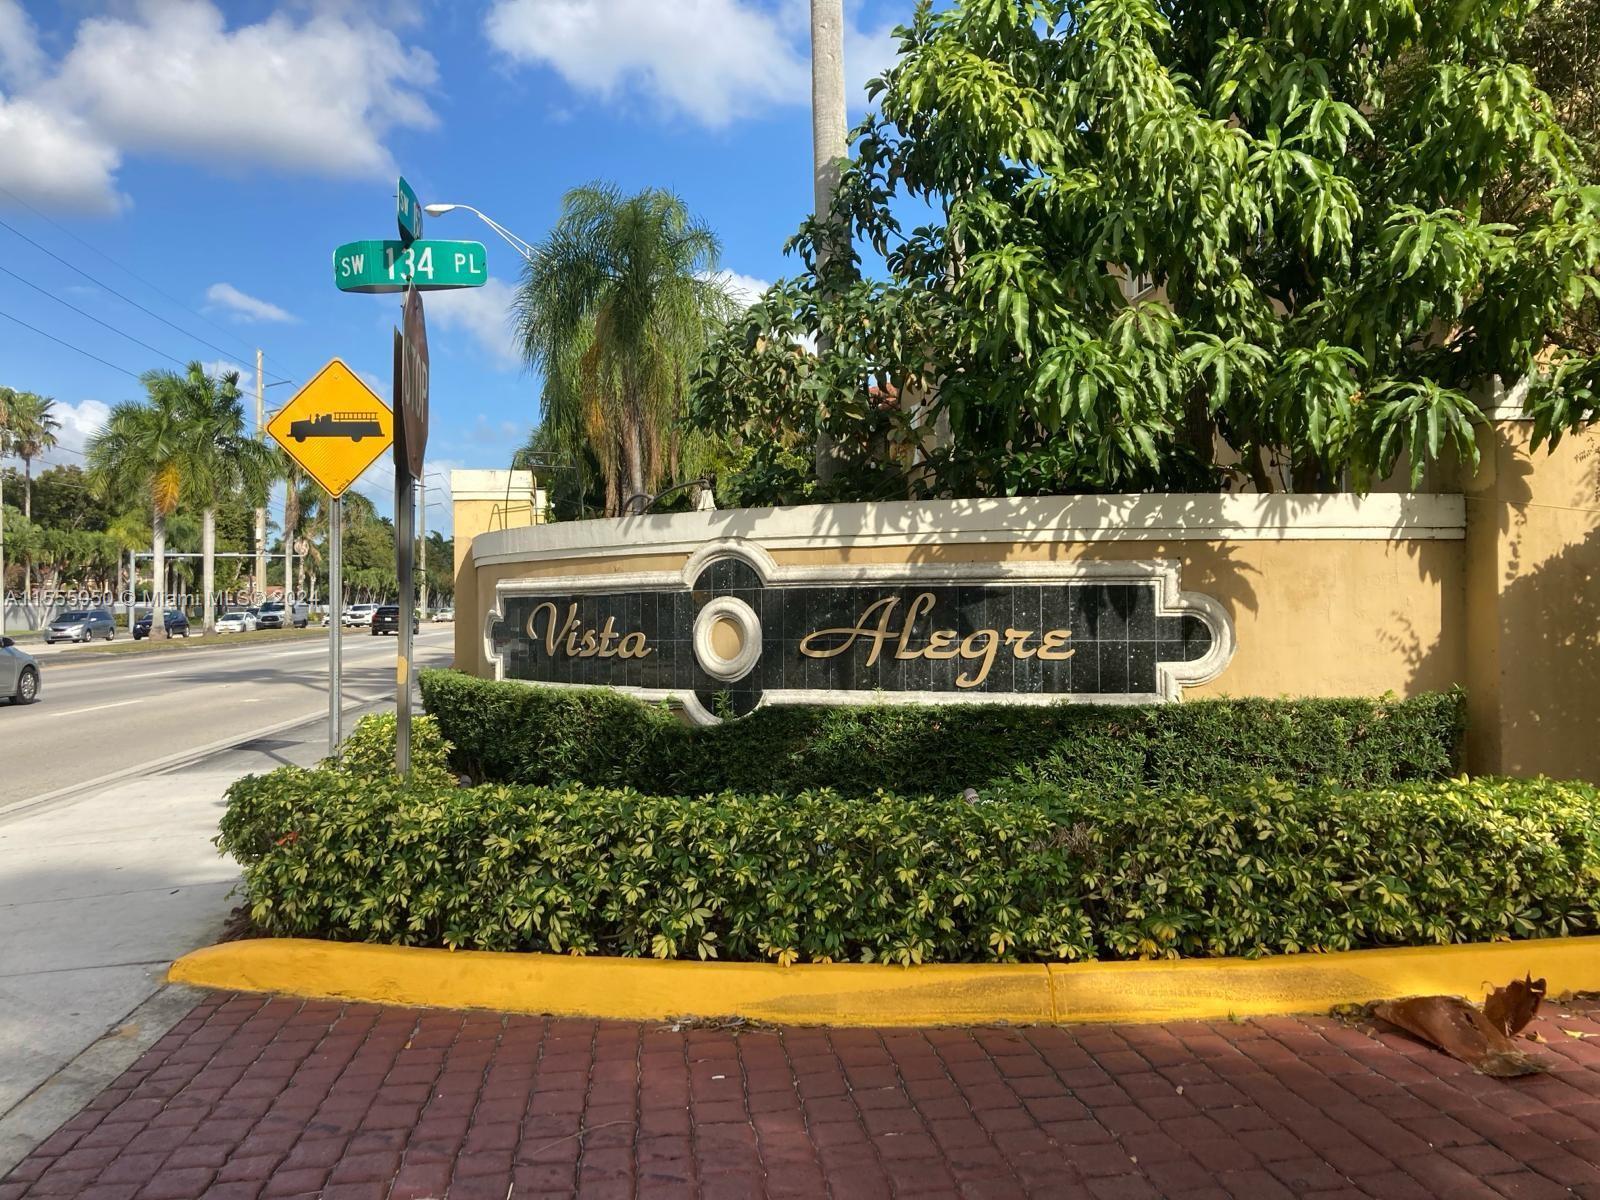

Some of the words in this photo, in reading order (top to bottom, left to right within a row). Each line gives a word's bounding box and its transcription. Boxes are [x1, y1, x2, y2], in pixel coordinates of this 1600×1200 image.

[341, 254, 365, 277] SW
[386, 247, 434, 280] 134
[455, 253, 481, 274] PL
[405, 338, 428, 423] STOP
[526, 601, 652, 659] Vista
[800, 592, 1075, 689] Alegre
